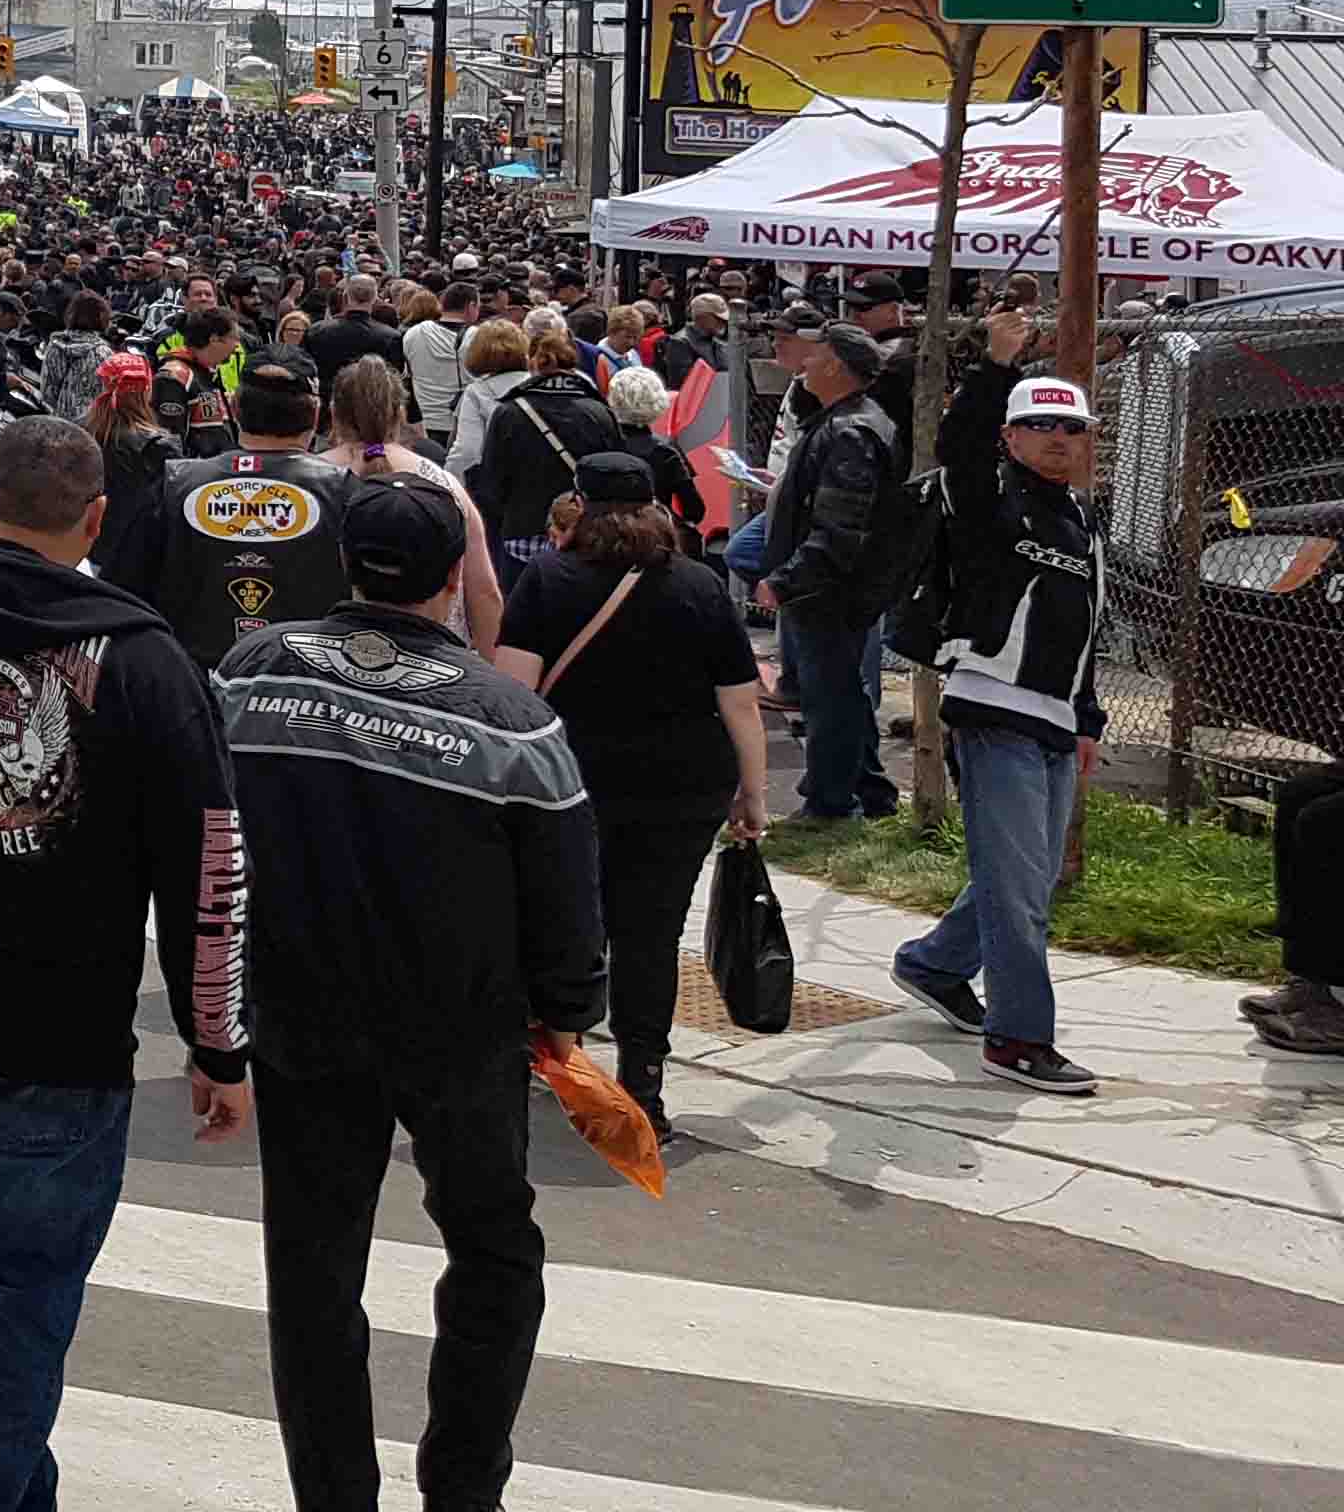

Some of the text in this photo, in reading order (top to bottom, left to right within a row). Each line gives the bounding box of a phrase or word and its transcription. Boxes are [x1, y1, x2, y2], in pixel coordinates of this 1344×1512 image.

[376, 44, 392, 65] 6
[673, 115, 721, 138] The
[740, 221, 873, 251] INDIAN
[886, 229, 1151, 259] MOTORCLE
[1163, 238, 1213, 262] OF
[213, 481, 289, 502] MOTORCYCLE
[207, 502, 294, 517] INFINITY
